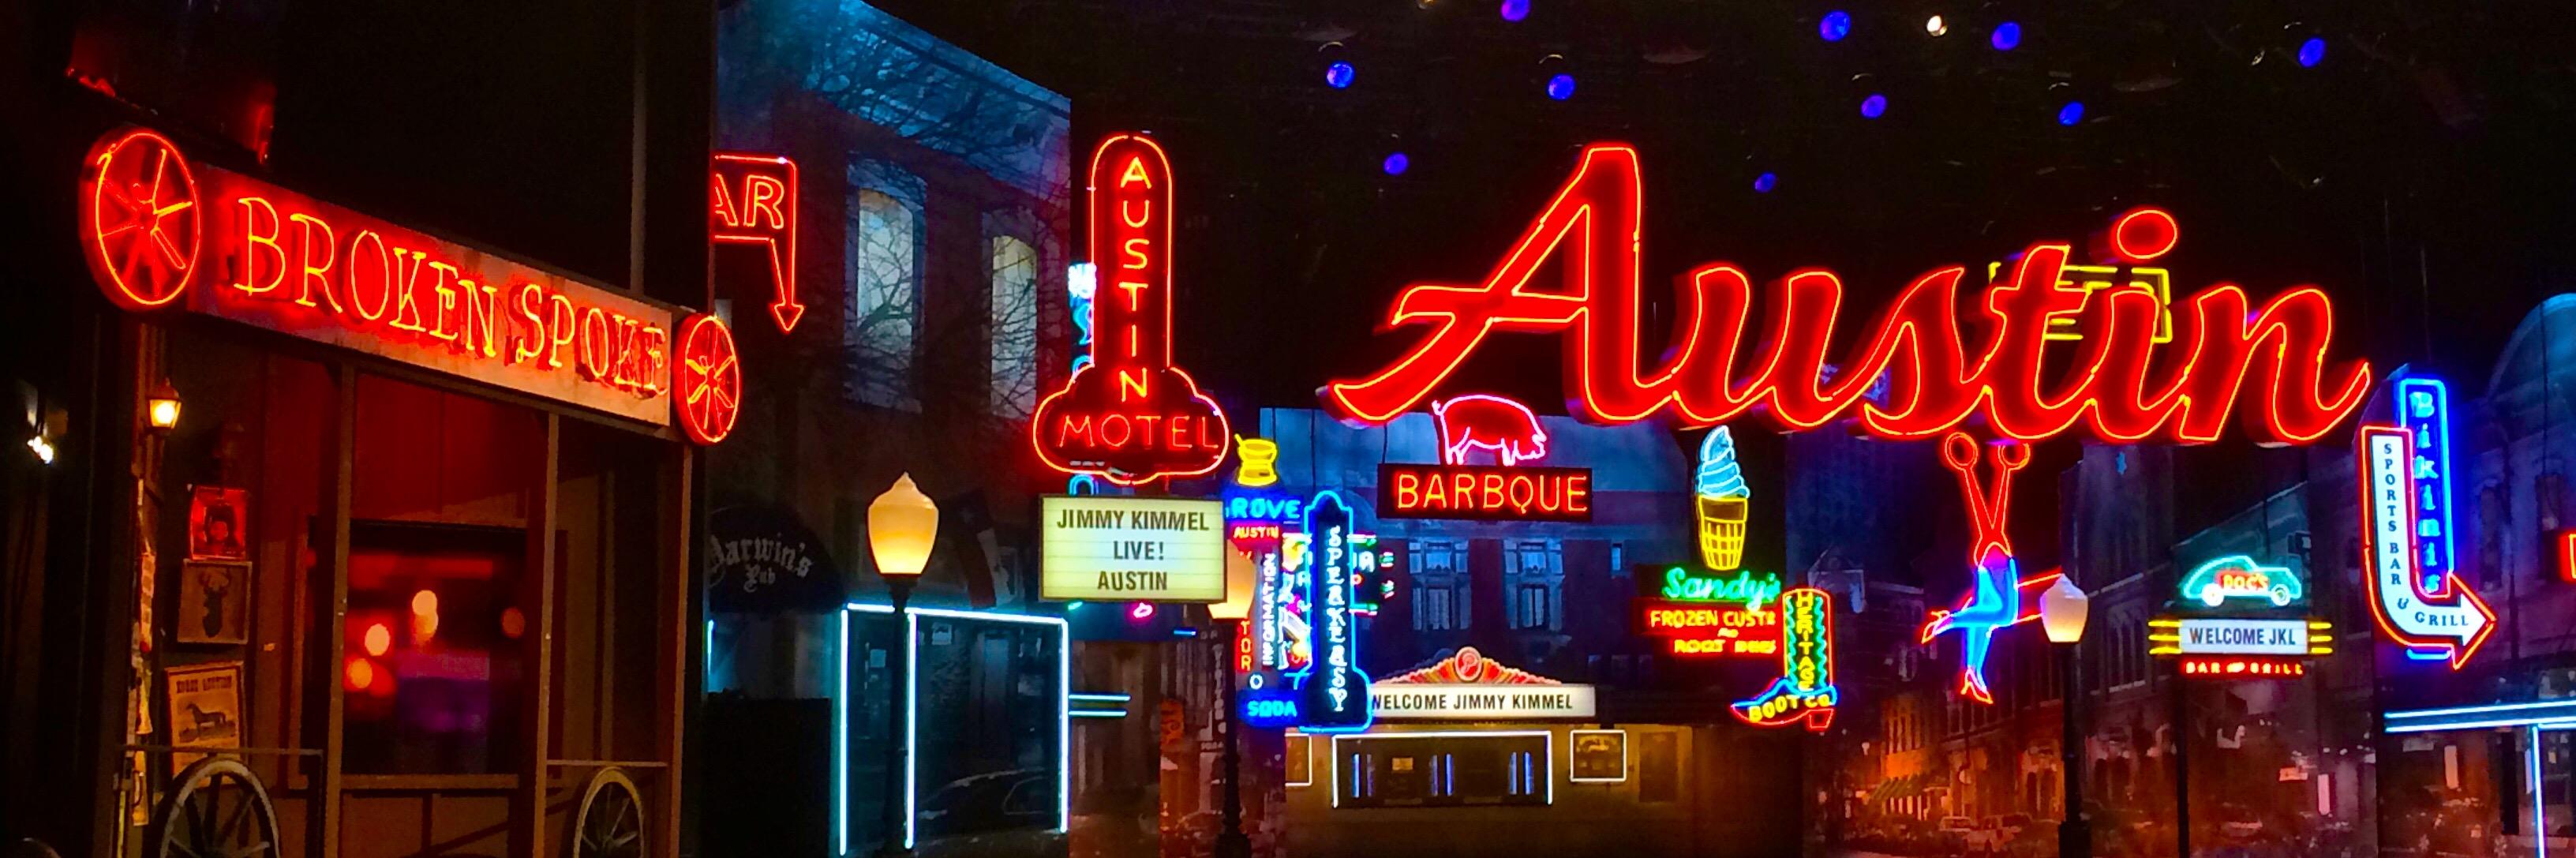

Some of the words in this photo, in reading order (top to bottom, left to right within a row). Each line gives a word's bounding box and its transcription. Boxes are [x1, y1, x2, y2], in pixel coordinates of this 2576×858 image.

[1120, 155, 1151, 402] AUSTIN
[234, 197, 499, 358] BROKEN
[515, 283, 669, 399] SPOKE
[1331, 145, 2370, 444] Austin
[1058, 413, 1219, 448] MOTEL
[1396, 473, 1588, 515] BARBQUE
[2383, 442, 2398, 533] SPORTS
[1057, 509, 1125, 531] JIMMY
[1130, 510, 1210, 531] KIMMEL
[1226, 496, 1301, 519] ROVE
[1233, 526, 1279, 539] AUSTIN
[1113, 540, 1165, 561] LIVE!
[2389, 541, 2402, 586] BAR
[1097, 569, 1168, 592] AUSTIN
[1662, 567, 1781, 612] Sandy's
[1325, 524, 1350, 713] SPEAKEASY
[1649, 609, 1719, 628] FROZEN
[2414, 610, 2469, 627] GRILL
[1795, 590, 1815, 692] HERITAGE
[2189, 628, 2264, 645] WELCOME
[2269, 628, 2296, 646] JKL
[2185, 661, 2221, 674] BAR
[1247, 700, 1298, 717] SODA
[1453, 694, 1506, 710] JIMMY
[1511, 693, 1573, 710] KIMMEL
[1748, 694, 1799, 724] BOOT
